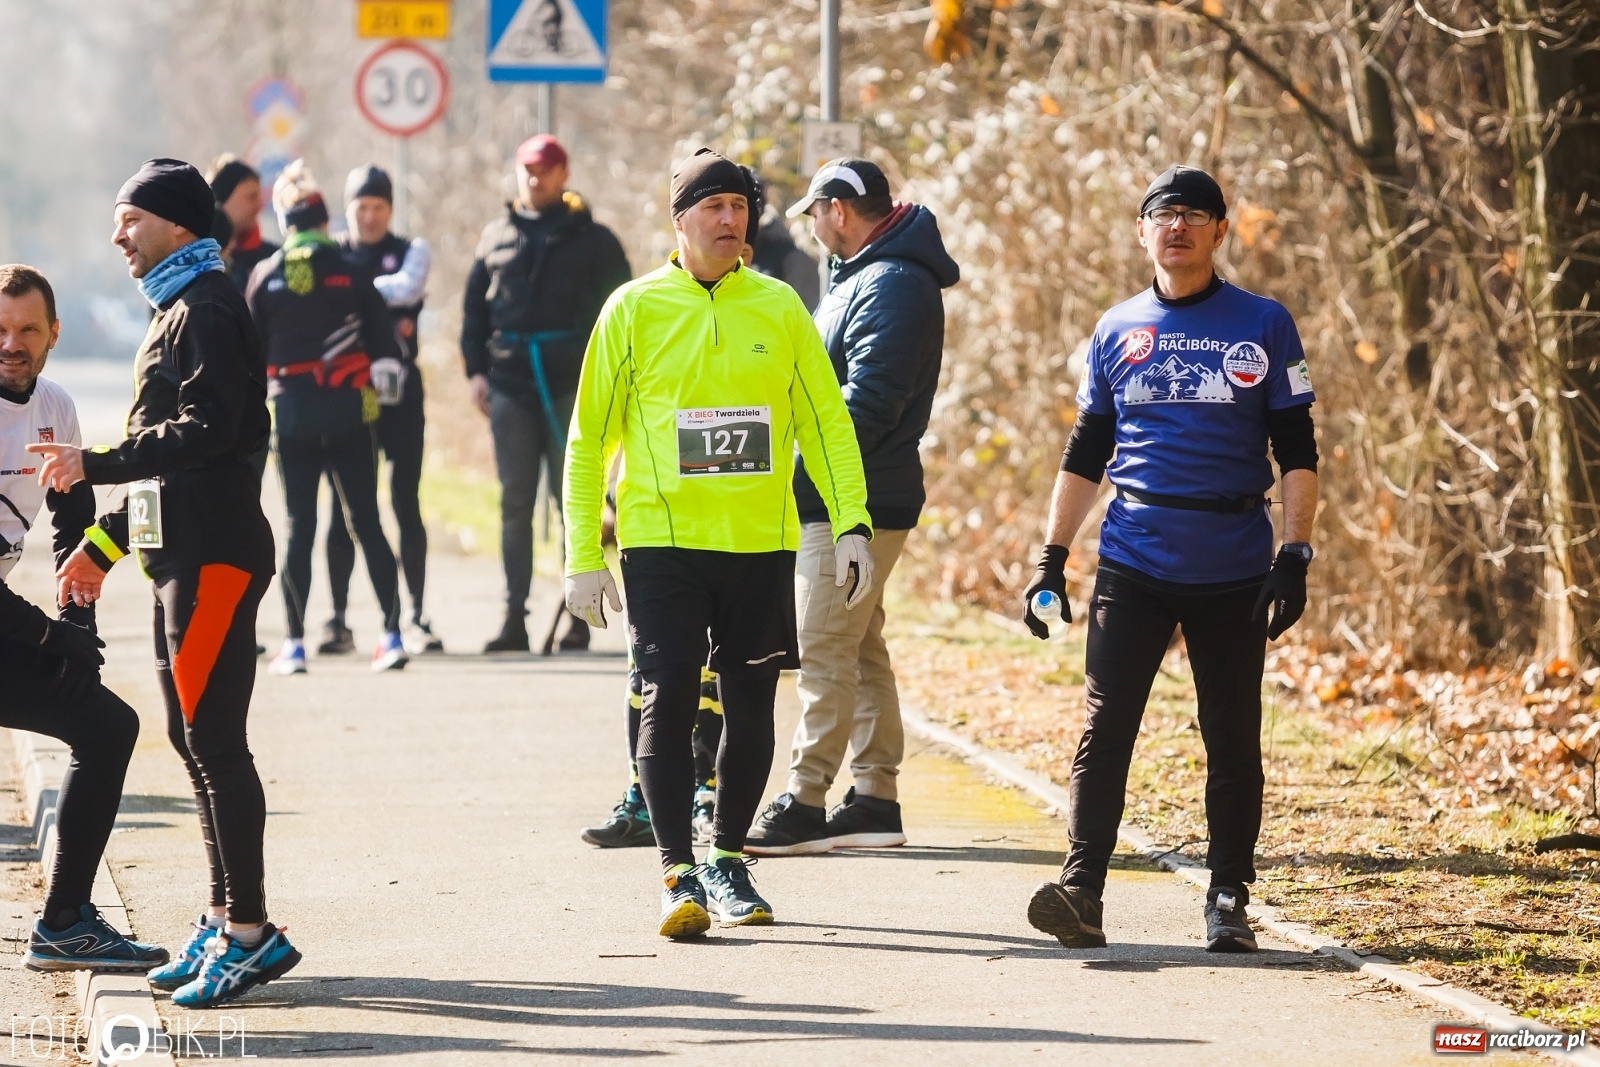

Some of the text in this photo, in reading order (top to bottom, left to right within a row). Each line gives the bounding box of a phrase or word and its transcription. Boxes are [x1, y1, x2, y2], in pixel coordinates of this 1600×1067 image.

[370, 67, 431, 108] 30
[1159, 337, 1229, 353] RACIBÓRZ
[715, 409, 760, 417] Twardziela
[701, 430, 749, 456] 127
